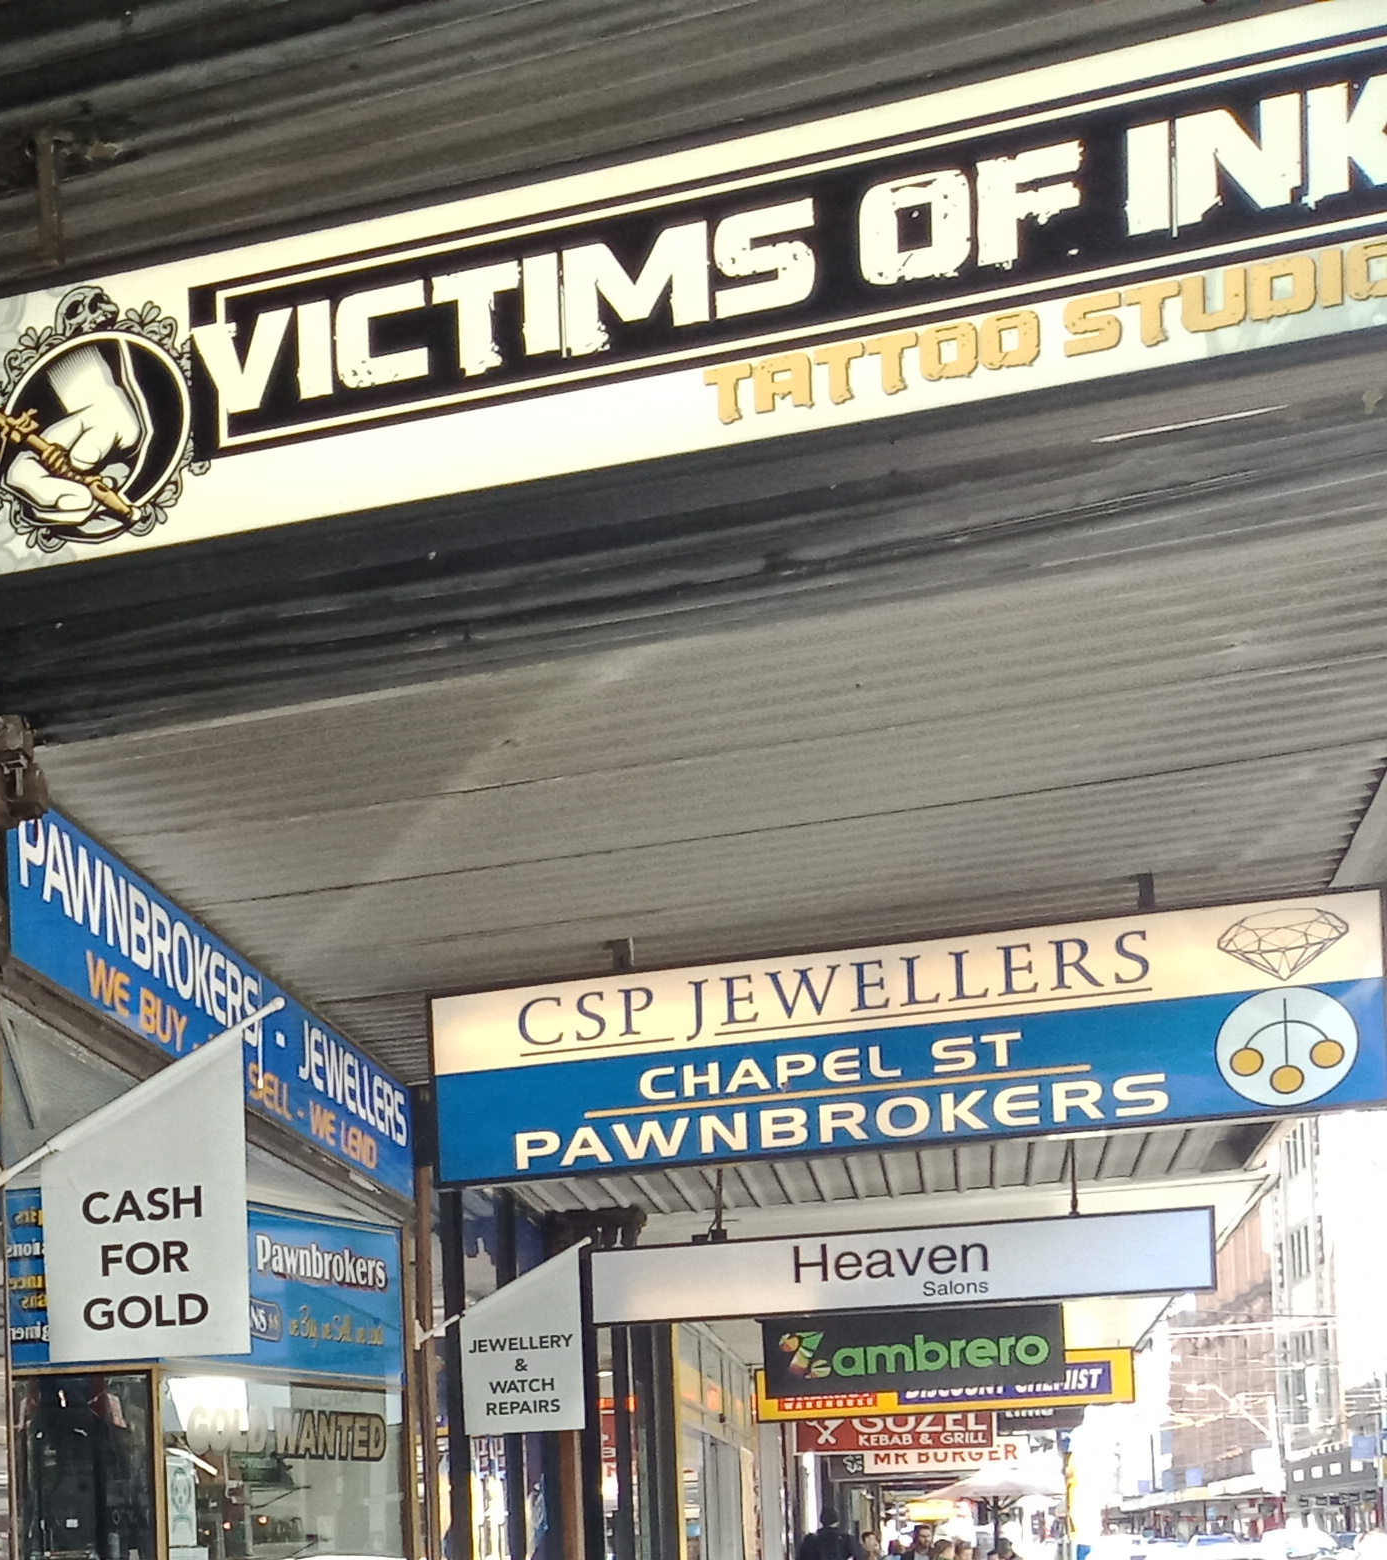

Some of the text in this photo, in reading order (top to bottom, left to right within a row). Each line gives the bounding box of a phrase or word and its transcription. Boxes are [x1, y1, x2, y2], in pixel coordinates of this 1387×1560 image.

[184, 73, 1387, 412] VICTIMS OF INK
[702, 240, 1387, 427] TATTOO STUDIO
[18, 818, 408, 1147] PAWNBROKERS JEWELLERS
[516, 929, 1152, 1047] CSP JEWELLERS
[86, 950, 378, 1170] WE BUY SELL WE LEND
[638, 1031, 1025, 1102] CHAPEL ST
[513, 1072, 1170, 1171] PAWNBROKERS
[82, 1185, 203, 1226] CASH
[100, 1240, 190, 1277] FOR
[255, 1233, 388, 1290] Pawnbrokers
[791, 1238, 990, 1285] Heaven
[922, 1279, 990, 1298] Salons
[83, 1292, 209, 1331] GOLD
[468, 1332, 573, 1355] JEWELLERY
[514, 1357, 529, 1373] &
[485, 1396, 562, 1417] REPAIRS
[489, 1376, 556, 1396] WATCH
[783, 1397, 875, 1410] WAREHOUSE
[186, 1403, 387, 1464] GOLD WANTED
[858, 1431, 988, 1447] KEBAB & GRILL
